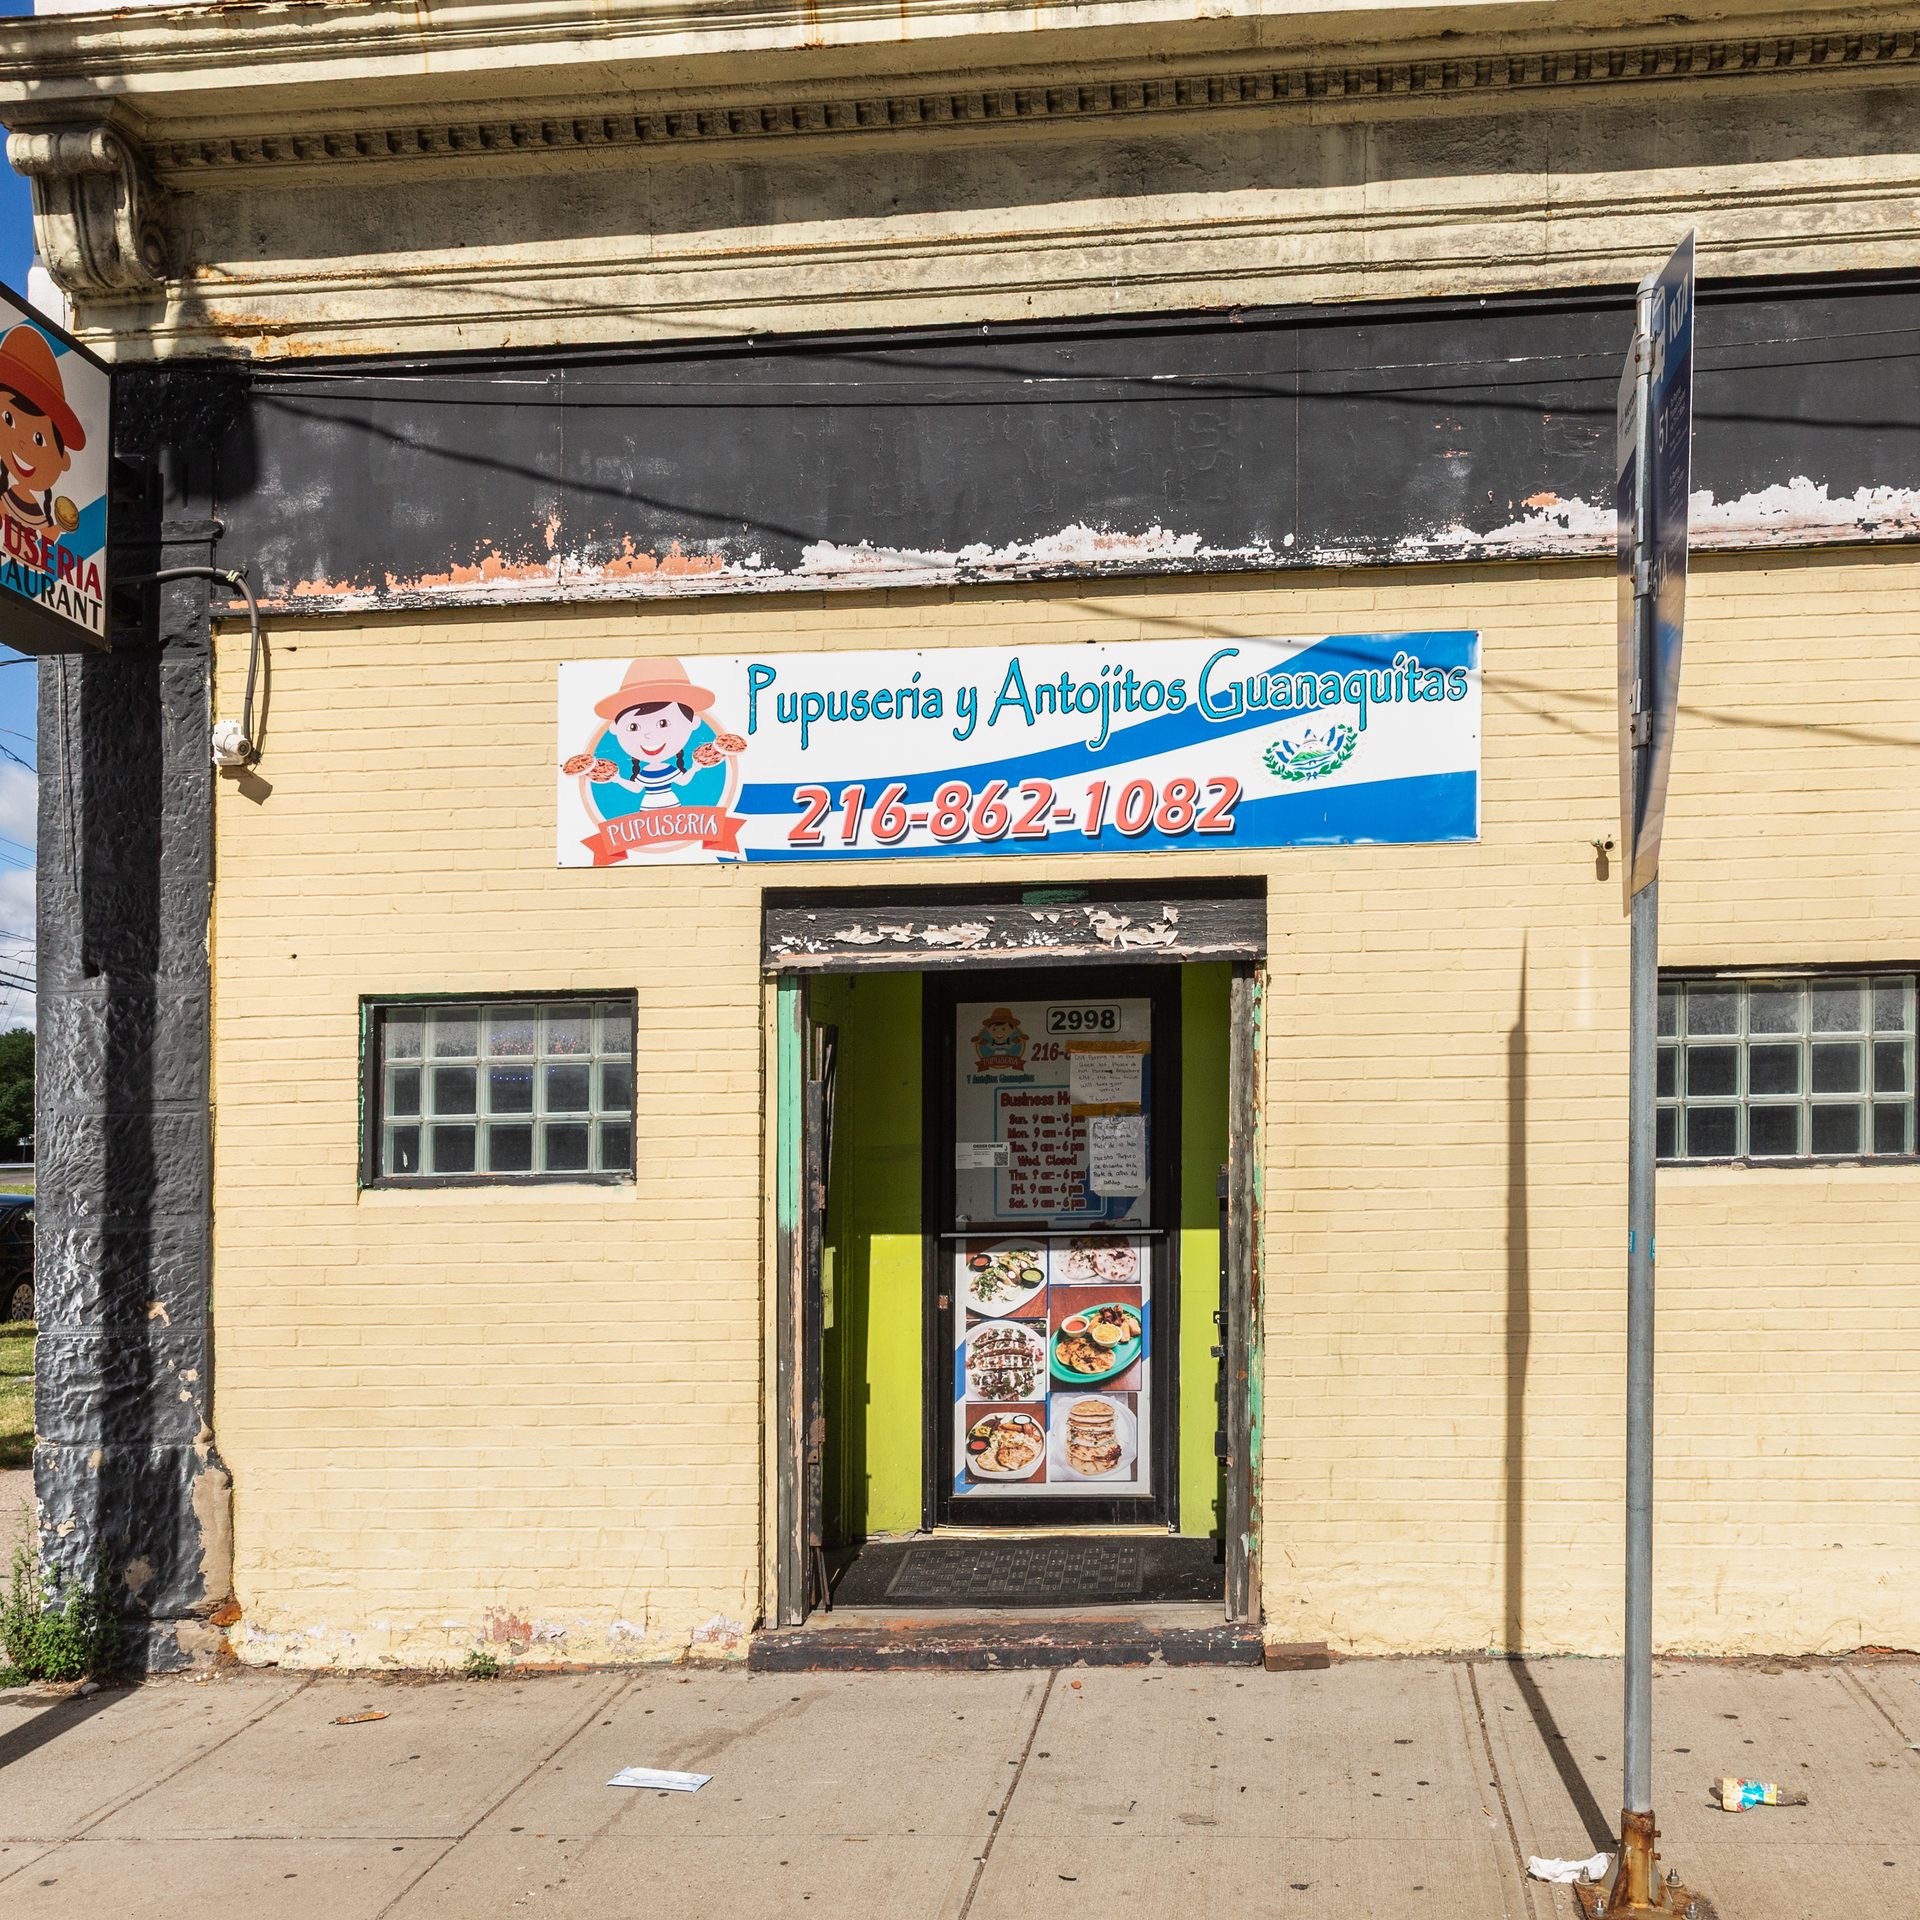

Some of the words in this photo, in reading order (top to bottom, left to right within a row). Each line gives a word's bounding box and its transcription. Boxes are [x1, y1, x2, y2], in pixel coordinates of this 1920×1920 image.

[1669, 272, 1689, 344] RTA
[1658, 406, 1669, 454] 51
[0, 514, 102, 600] USERIA
[953, 686, 978, 741] y
[787, 776, 1243, 846] 216-862-1082
[606, 813, 719, 846] PUPUSERIA
[1051, 1009, 1115, 1031] 2998
[1001, 1092, 1054, 1107] Business
[1032, 1114, 1039, 1124] 9
[1040, 1116, 1055, 1124] am
[1062, 1113, 1069, 1123] 6
[1071, 1116, 1085, 1127] pm
[1034, 1127, 1040, 1137] 9
[1042, 1130, 1056, 1138] am
[1064, 1127, 1071, 1137] 6
[1073, 1129, 1086, 1140] pm
[1032, 1141, 1038, 1152] 9
[1040, 1144, 1054, 1152] am
[1062, 1141, 1068, 1151] 6
[1071, 1143, 1084, 1155] pm
[1045, 1154, 1077, 1166] Closed
[1033, 1169, 1039, 1179] 9
[1063, 1169, 1069, 1179] 6
[1071, 1171, 1085, 1182] pm
[1030, 1183, 1036, 1193] 9
[1038, 1186, 1052, 1194] am
[1060, 1183, 1067, 1193] 6
[1069, 1185, 1082, 1196] pm
[1032, 1197, 1038, 1208] 9
[1040, 1200, 1055, 1208] am
[1063, 1197, 1069, 1207] 6
[1071, 1199, 1085, 1211] pm
